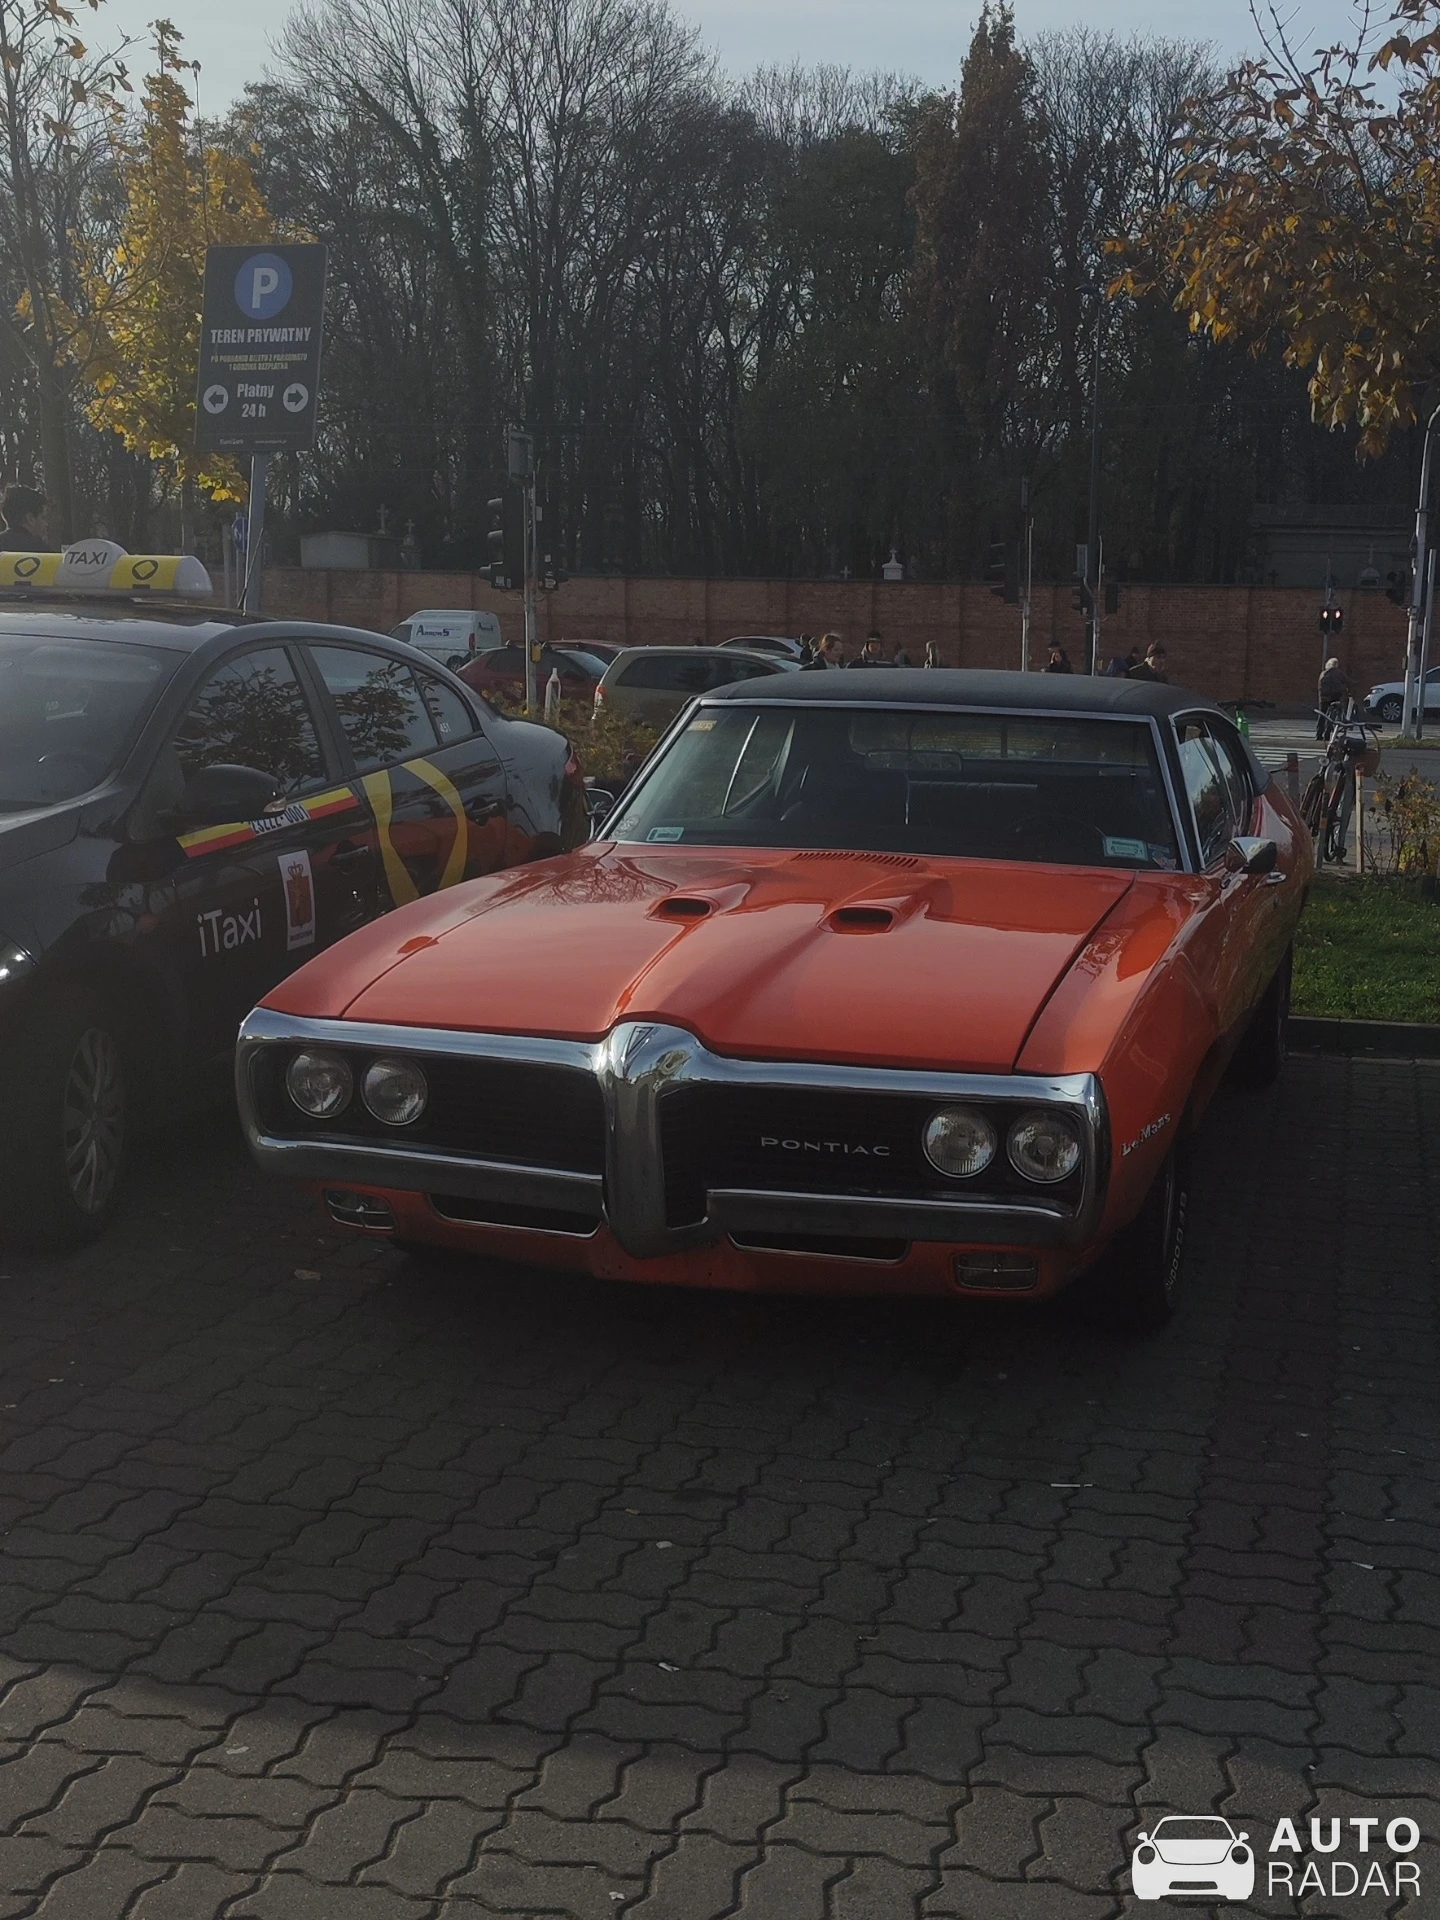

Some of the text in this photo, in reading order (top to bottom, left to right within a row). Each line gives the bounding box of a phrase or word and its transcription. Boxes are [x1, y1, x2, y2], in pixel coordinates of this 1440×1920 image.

[252, 267, 279, 309] P
[210, 326, 312, 344] TEREN PRYWATNY
[236, 383, 275, 399] Płatny
[241, 403, 267, 418] 24 h
[67, 551, 108, 565] TAXI
[196, 897, 262, 957] iTaxi
[1121, 1113, 1171, 1157] Le Mans
[760, 1136, 890, 1157] PONTIAC
